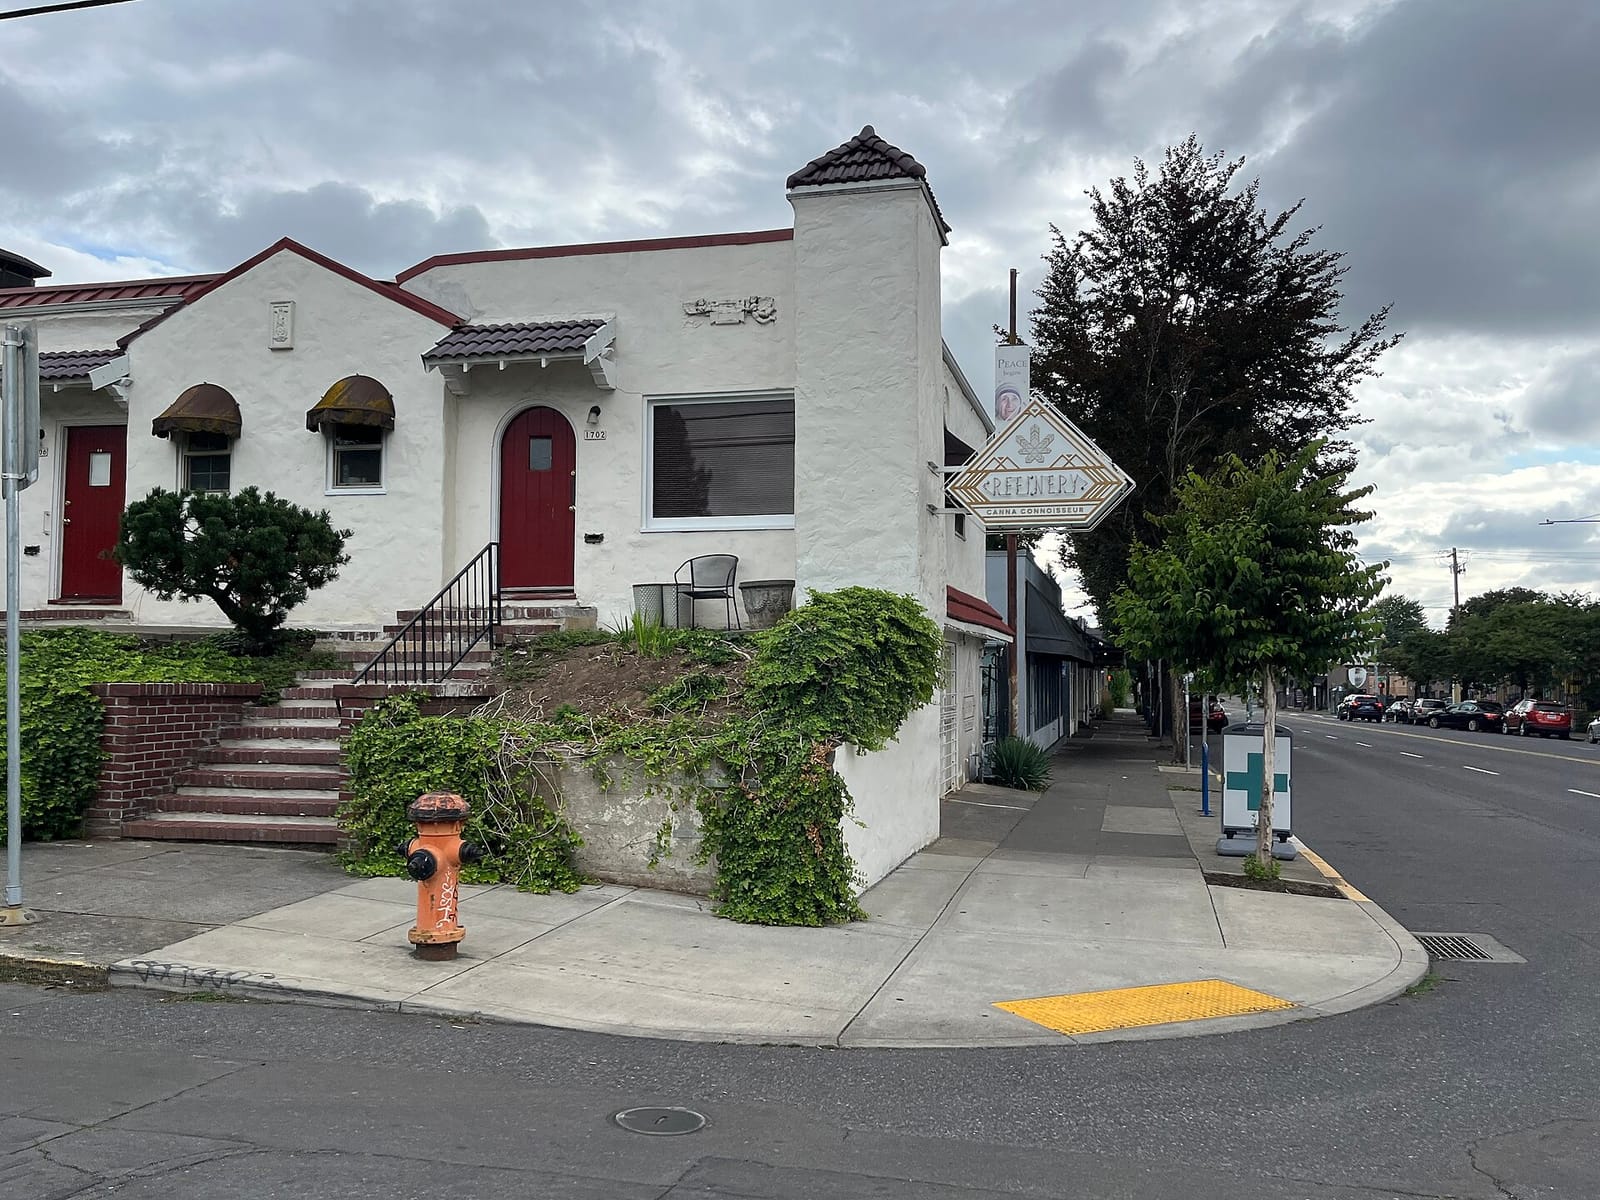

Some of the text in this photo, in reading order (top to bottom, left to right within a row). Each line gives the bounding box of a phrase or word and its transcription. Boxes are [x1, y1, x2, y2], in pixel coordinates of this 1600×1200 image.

[992, 474, 1080, 496] REFINERY
[986, 507, 1084, 516] CANNA CONNOISSEUR
